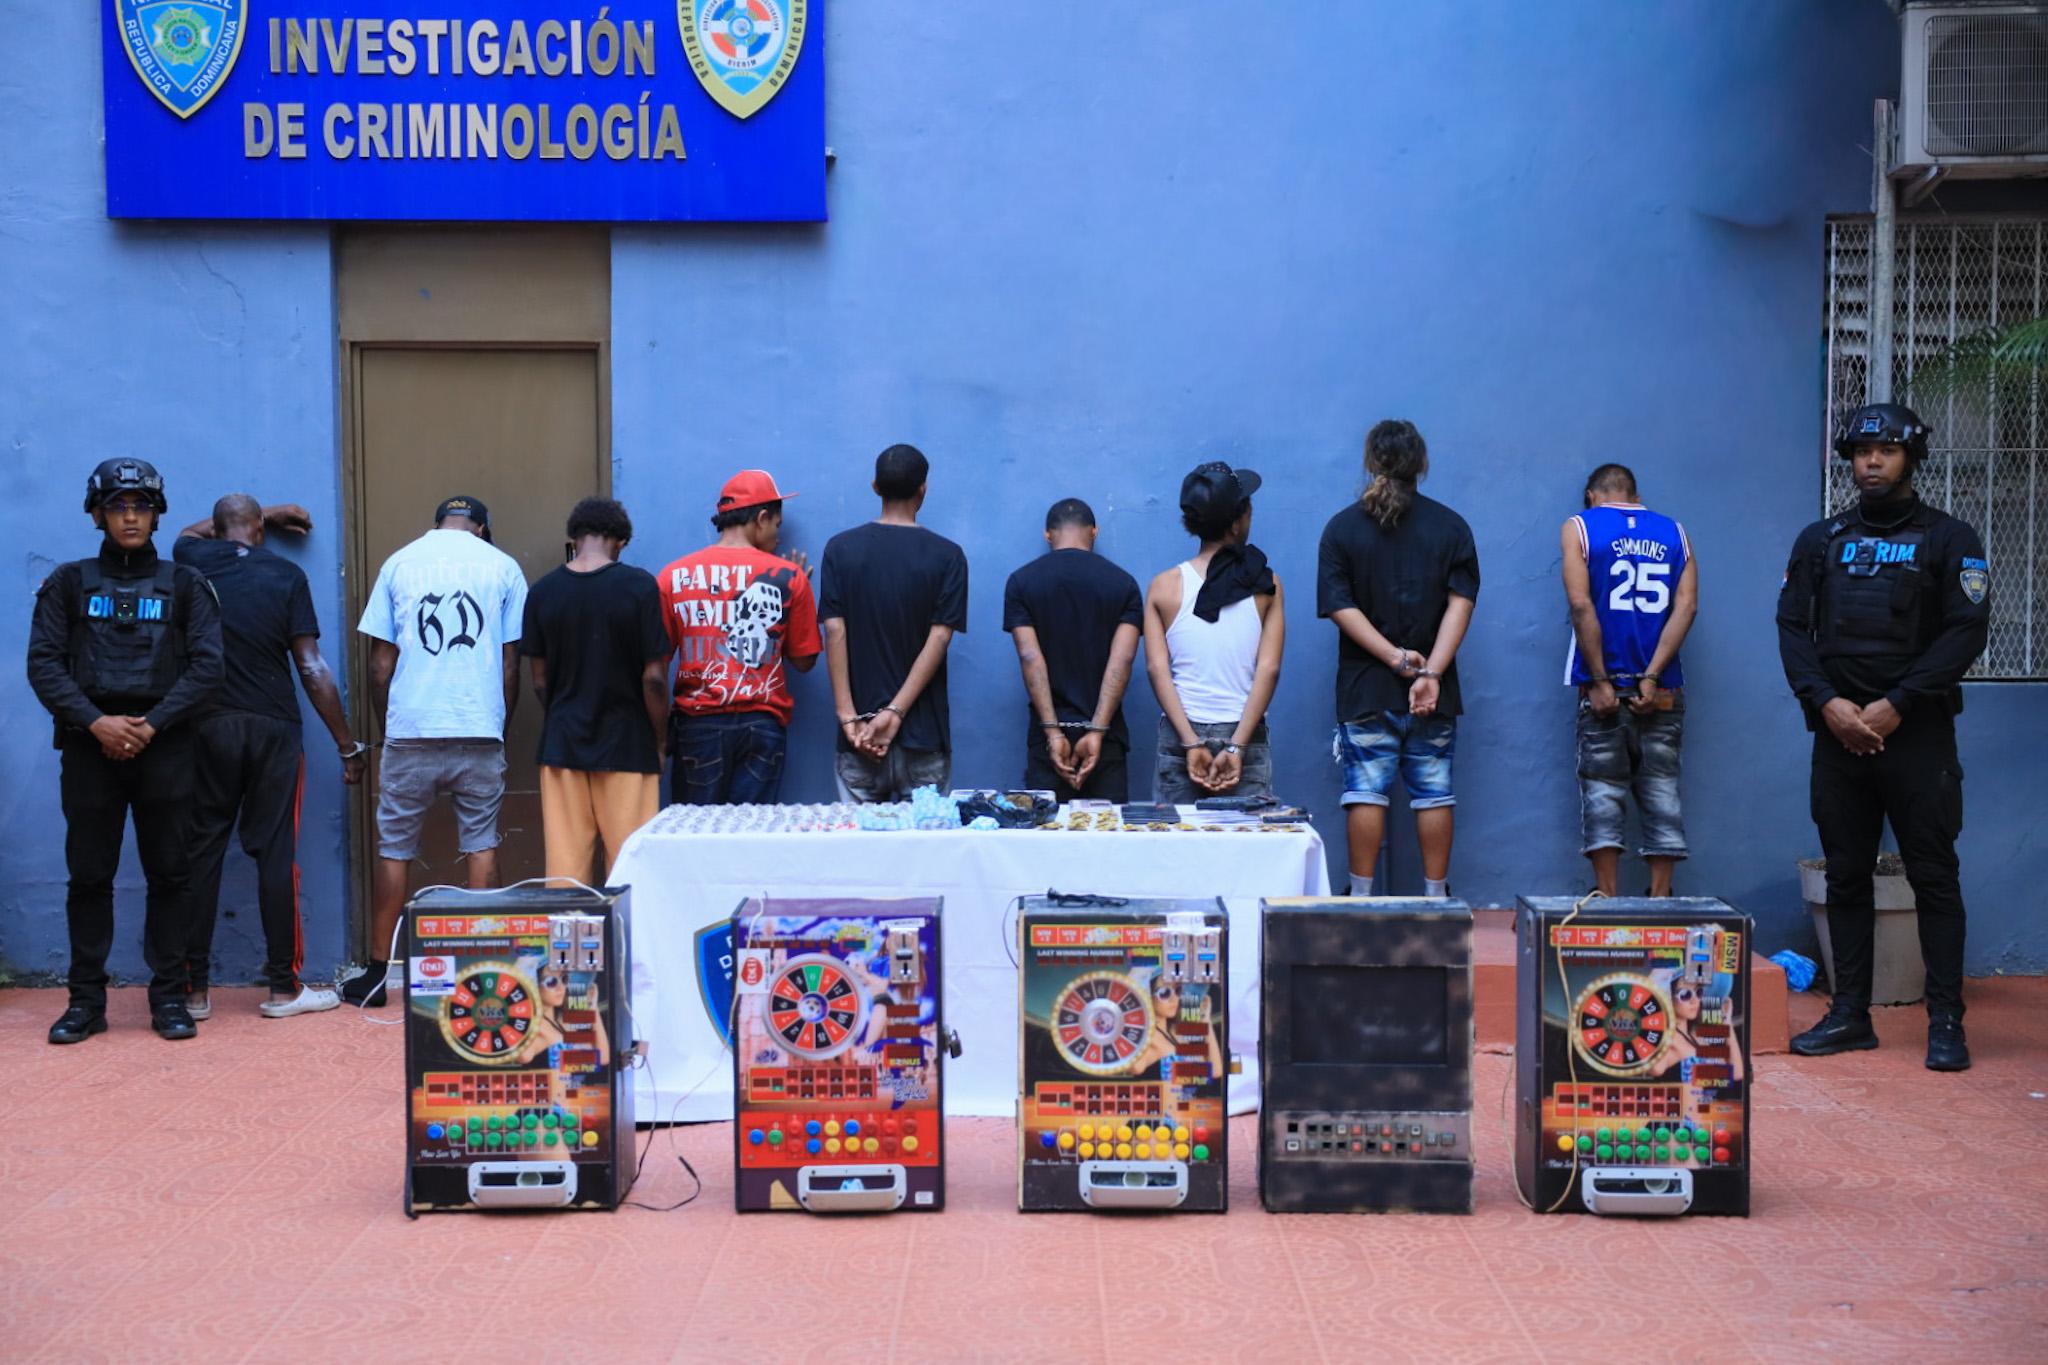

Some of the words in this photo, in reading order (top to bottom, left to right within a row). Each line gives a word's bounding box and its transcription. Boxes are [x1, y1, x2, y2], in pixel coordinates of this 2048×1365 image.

[126, 19, 172, 94] REPUBLICA
[190, 20, 237, 97] DOMINICANA
[269, 7, 656, 76] INVESTIGACIÓN
[681, 0, 709, 79] EPUBLICA
[243, 102, 307, 159] DE
[323, 90, 687, 160] CRIMINOLOGÍA
[1611, 537, 1668, 562] SIMMONS
[1841, 542, 1916, 563] DRIM
[672, 564, 752, 594] PART
[1609, 559, 1670, 614] 25
[88, 596, 163, 619] DIIM
[1560, 950, 1575, 958] AST
[1726, 935, 1738, 970] MSM
[1702, 1010, 1723, 1024] PLUS
